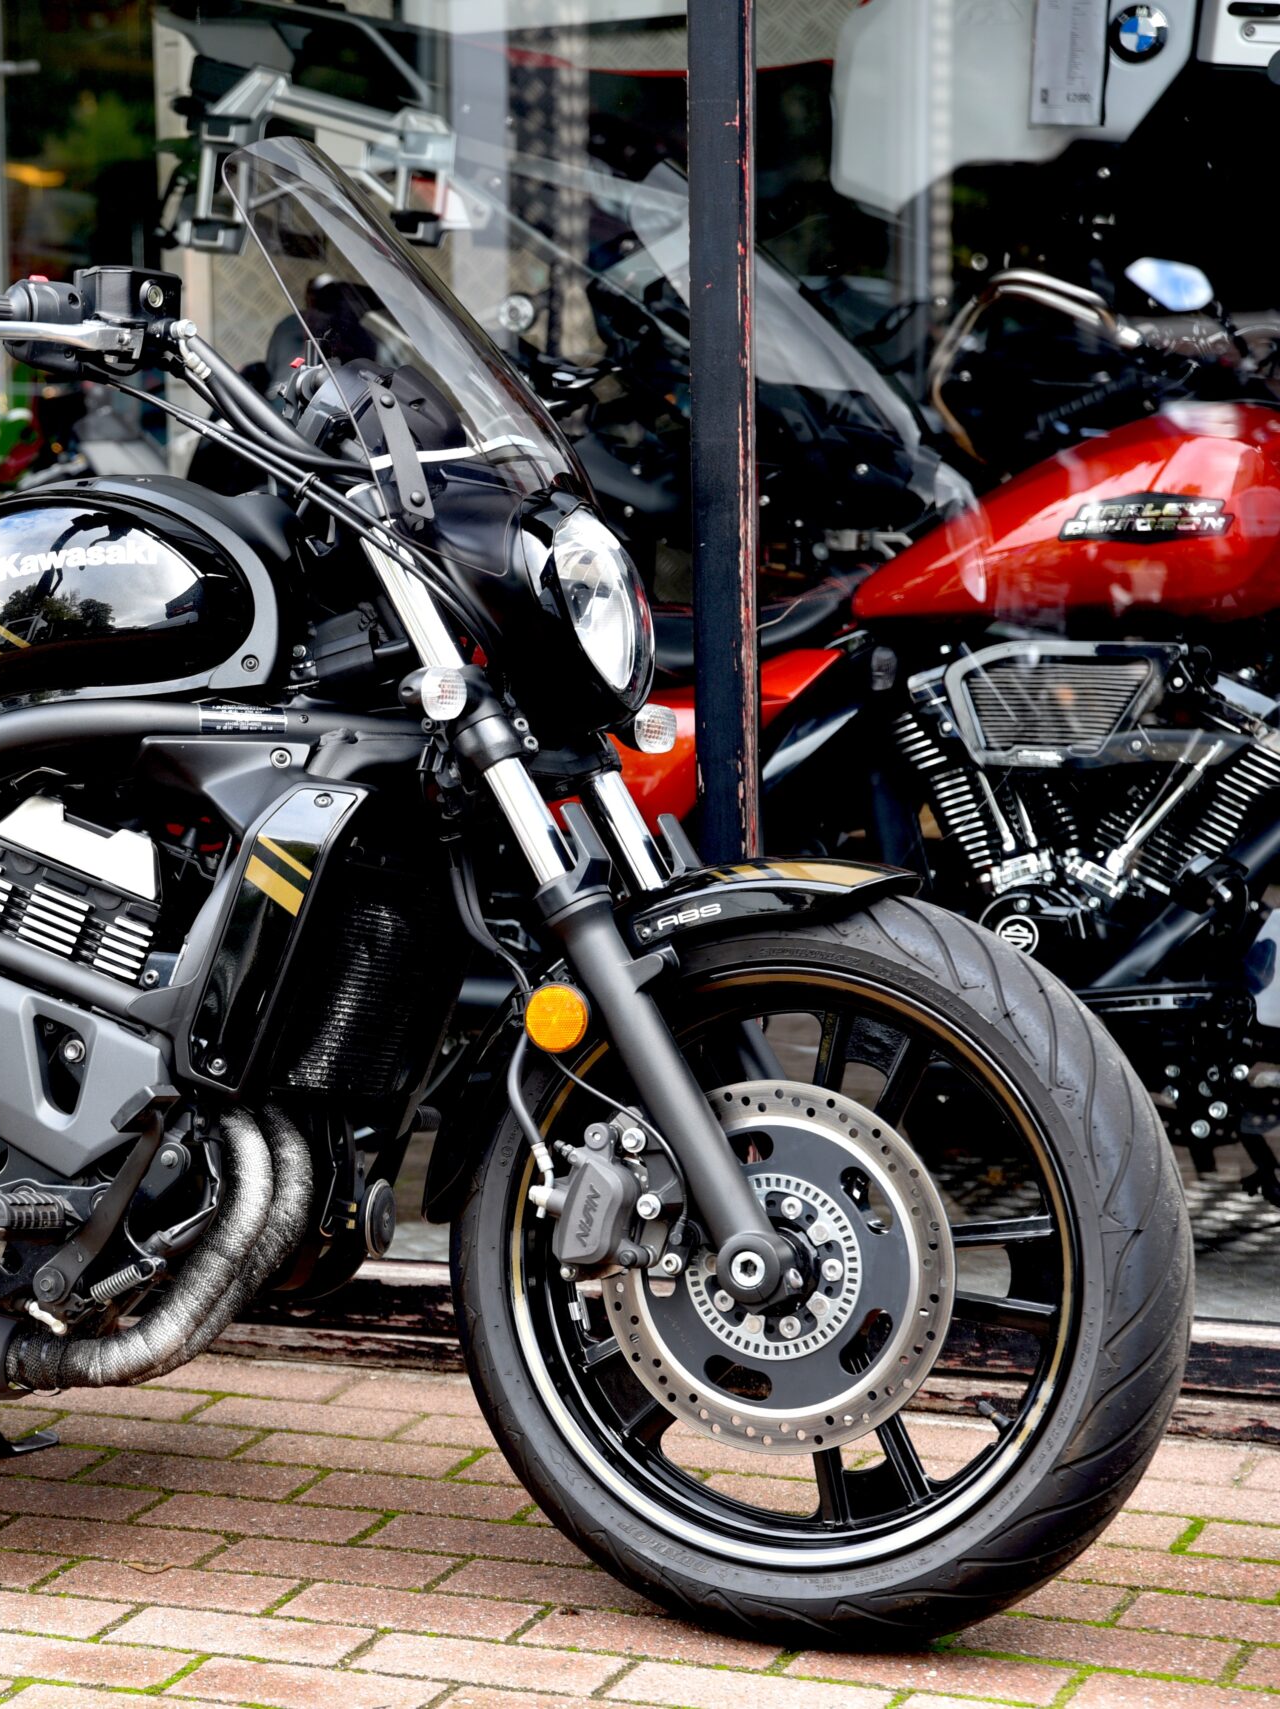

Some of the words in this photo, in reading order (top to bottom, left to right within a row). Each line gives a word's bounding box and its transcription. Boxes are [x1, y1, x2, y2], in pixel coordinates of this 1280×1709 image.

[0, 541, 157, 582] Kawasaki
[657, 904, 721, 930] ABS
[618, 1521, 711, 1575] DUNLOP
